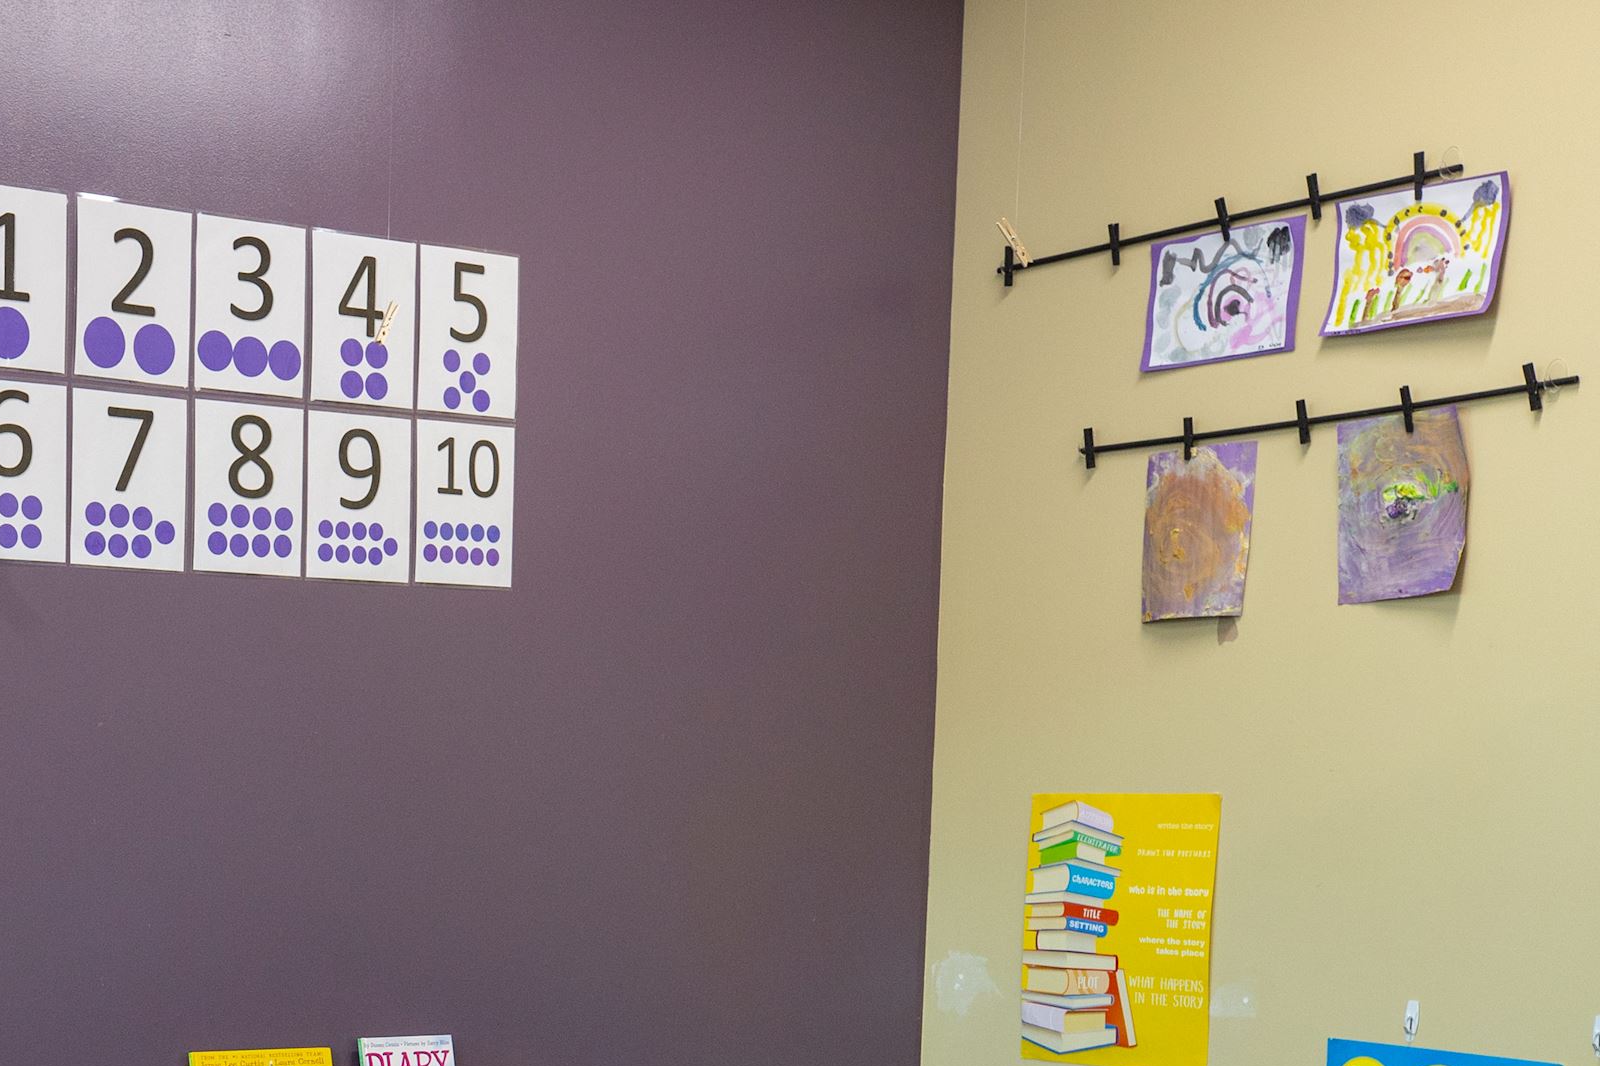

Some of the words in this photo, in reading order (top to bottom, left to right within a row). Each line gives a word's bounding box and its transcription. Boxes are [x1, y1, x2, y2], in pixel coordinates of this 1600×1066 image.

[111, 228, 155, 317] 2
[229, 236, 274, 321] 3
[338, 255, 384, 337] 4
[449, 261, 488, 343] 5
[107, 406, 154, 492] 7
[228, 414, 274, 499] 8
[338, 428, 381, 510] 9
[437, 437, 500, 498] 10
[1147, 886, 1156, 895] is
[1157, 886, 1166, 896] in
[1184, 889, 1210, 898] story
[1157, 908, 1170, 918] THE
[1197, 909, 1206, 919] OF
[1069, 920, 1104, 934] SETTING
[1166, 919, 1179, 929] THE
[1183, 919, 1206, 930] STORY
[1139, 935, 1166, 944] where
[1167, 936, 1181, 945] the
[1183, 938, 1205, 948] story
[1156, 947, 1179, 956] takes
[1181, 948, 1205, 958] place
[1077, 976, 1100, 990] PLOT
[1128, 976, 1155, 989] WHAT
[1160, 978, 1204, 993] HAPPENS
[1134, 992, 1145, 1004] IN
[1151, 993, 1167, 1006] THE
[1173, 994, 1204, 1009] STORY
